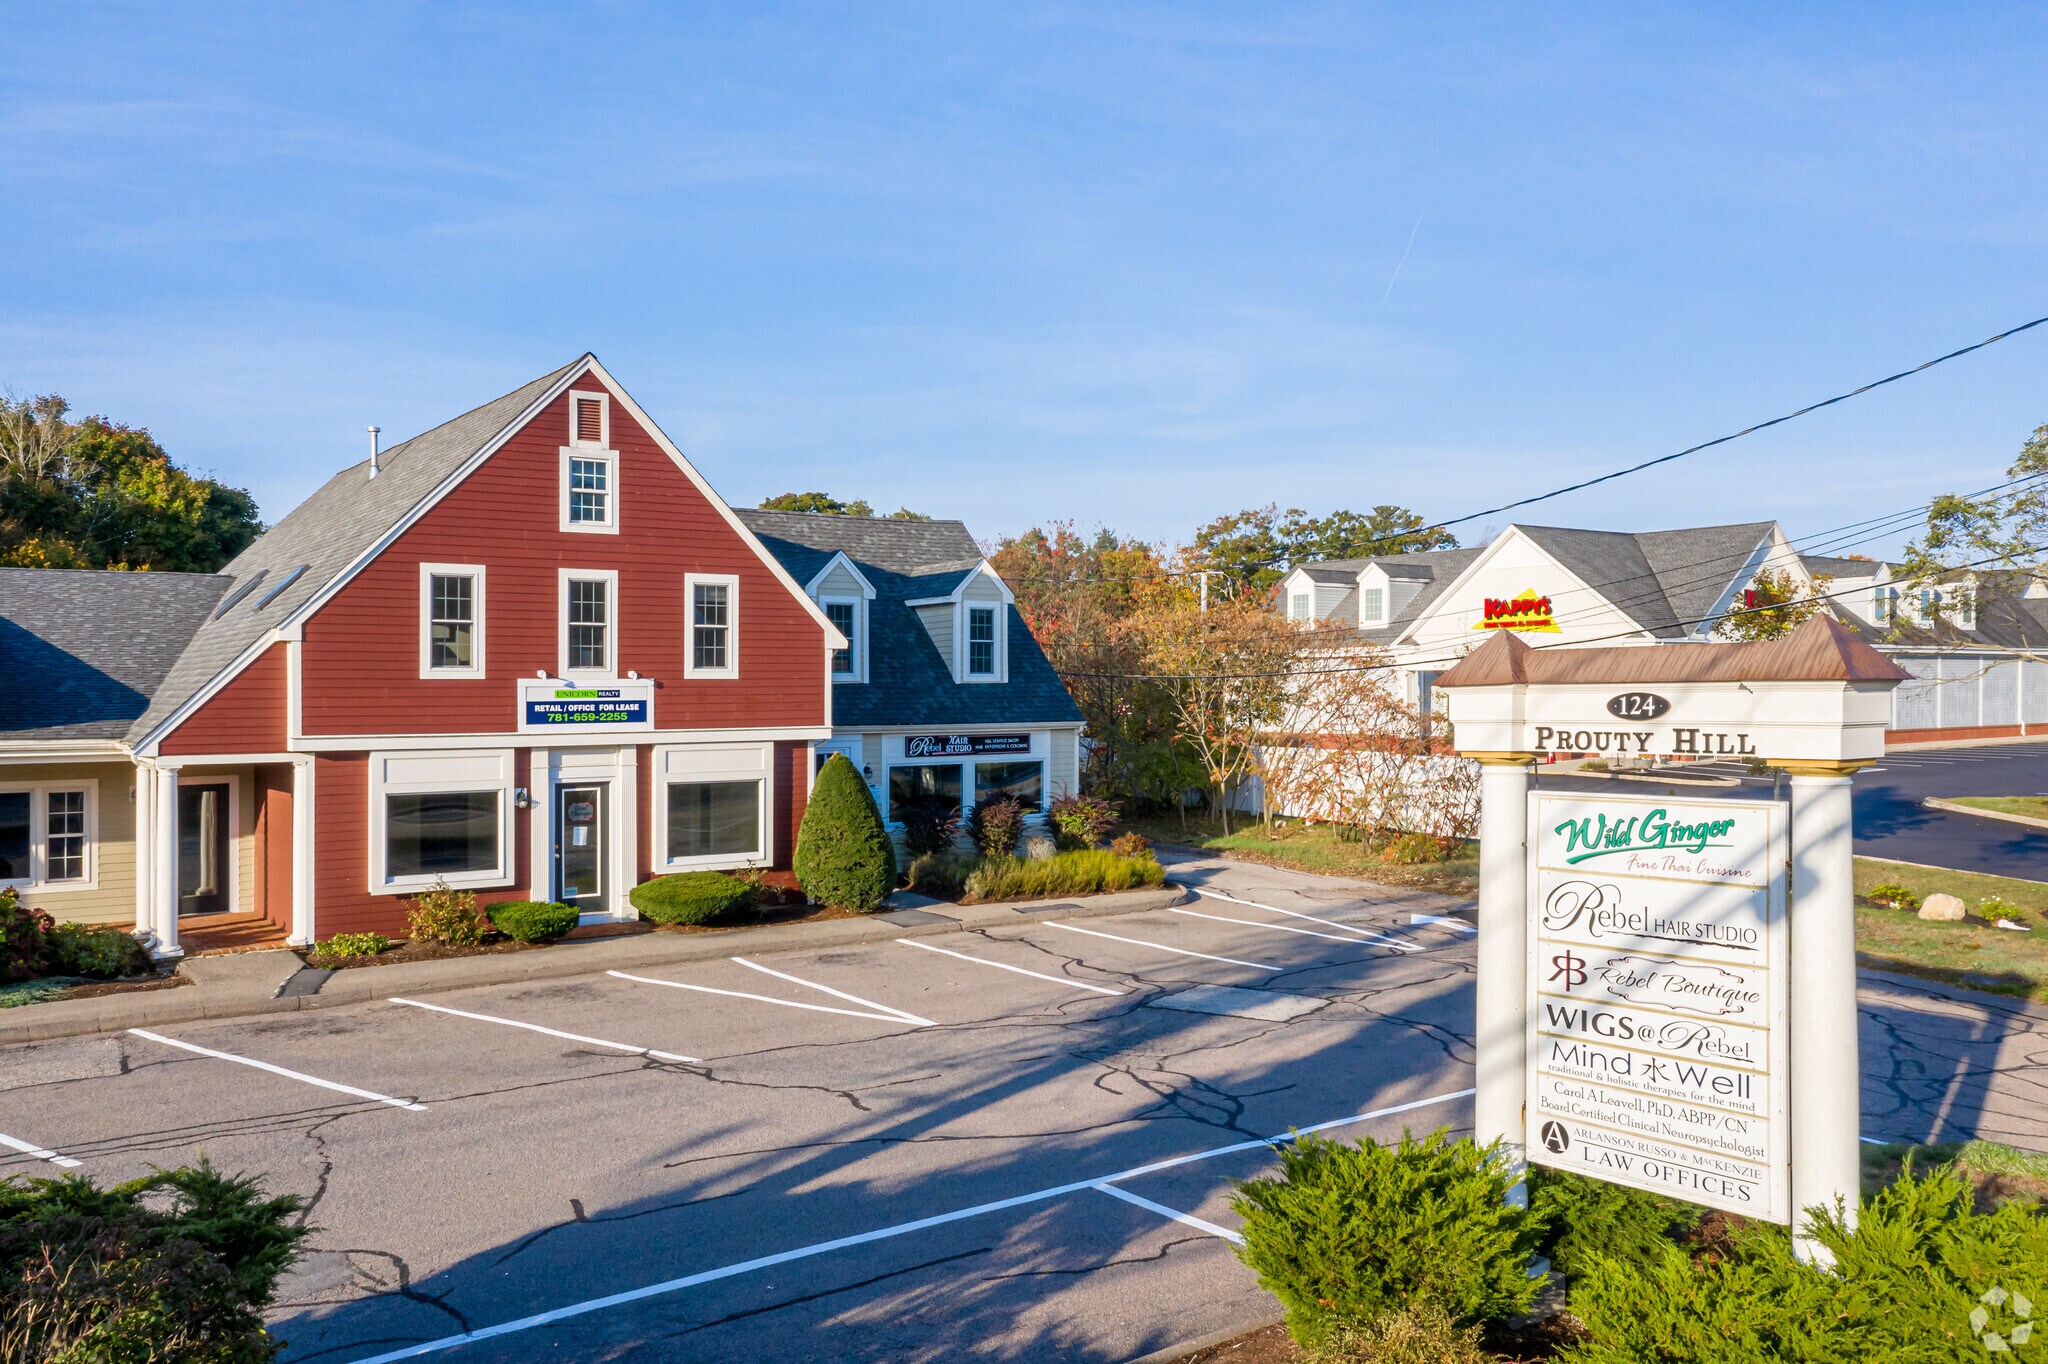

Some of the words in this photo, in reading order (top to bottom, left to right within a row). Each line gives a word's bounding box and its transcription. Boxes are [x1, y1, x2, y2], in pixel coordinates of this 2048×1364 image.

[534, 704, 562, 712] RETAIL
[568, 704, 596, 712] OFFICE
[616, 703, 640, 711] LEASE
[547, 712, 628, 722] 781-659-2255
[1619, 696, 1656, 717] 124
[909, 736, 942, 756] Rebel
[945, 744, 972, 752] STUDIO
[948, 735, 969, 745] HAIR
[1535, 727, 1654, 752] PROUTY
[1672, 728, 1756, 755] HILL
[1555, 813, 1639, 851] Wild
[1639, 809, 1735, 853] Ginger
[1626, 853, 1658, 871] Fine
[1659, 856, 1692, 873] Thai
[1696, 858, 1752, 878] Cuisine
[1543, 880, 1649, 937] Rebel
[1655, 918, 1690, 937] HAIR
[1695, 922, 1757, 944] STUDIO
[1594, 966, 1658, 989] Rebel
[1663, 974, 1760, 1007] Boutique
[1546, 1003, 1635, 1040] WIGS
[1657, 1021, 1751, 1057] Rebel
[1548, 1063, 1593, 1079] traditional
[1596, 1072, 1604, 1081] &
[1607, 1073, 1640, 1089] holistic
[1643, 1082, 1687, 1099] therapies
[1690, 1091, 1706, 1101] for
[1708, 1095, 1725, 1106] the
[1729, 1101, 1755, 1112] mind
[1552, 1040, 1631, 1076] Mind
[1675, 1061, 1750, 1099] Well
[1554, 1081, 1584, 1099] Carol
[1587, 1089, 1598, 1102] A
[1600, 1090, 1645, 1113] Leavell,
[1647, 1100, 1676, 1120] PhD,
[1541, 1095, 1570, 1113] Board
[1571, 1103, 1616, 1124] Certified
[1618, 1113, 1660, 1134] Clinical
[1661, 1122, 1765, 1157] Neuropsychologist
[1573, 1127, 1635, 1149] ARLANSON
[1638, 1142, 1678, 1159] RUSSO
[1680, 1153, 1689, 1161] &
[1583, 1146, 1634, 1171] LAW
[1643, 1161, 1752, 1202] OFFICES
